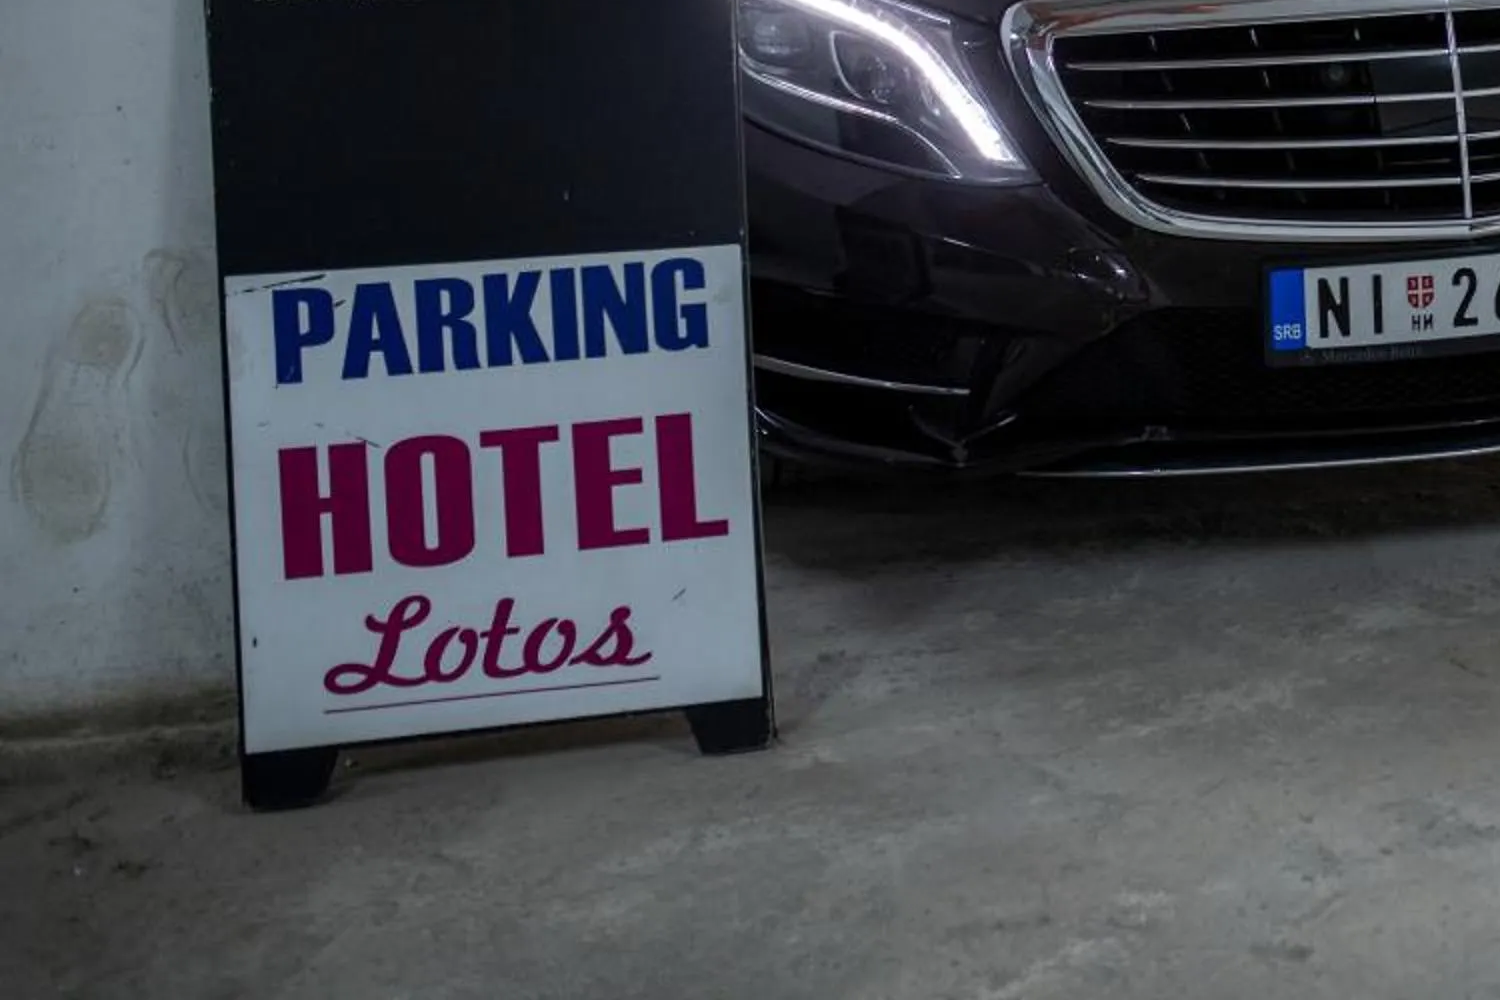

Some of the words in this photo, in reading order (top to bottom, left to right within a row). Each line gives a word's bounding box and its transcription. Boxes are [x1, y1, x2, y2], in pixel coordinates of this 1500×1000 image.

[272, 258, 710, 384] PARKING
[1274, 323, 1301, 341] SRB
[1318, 275, 1383, 338] NI
[278, 413, 729, 579] HOTEL
[323, 594, 652, 695] Lotos
